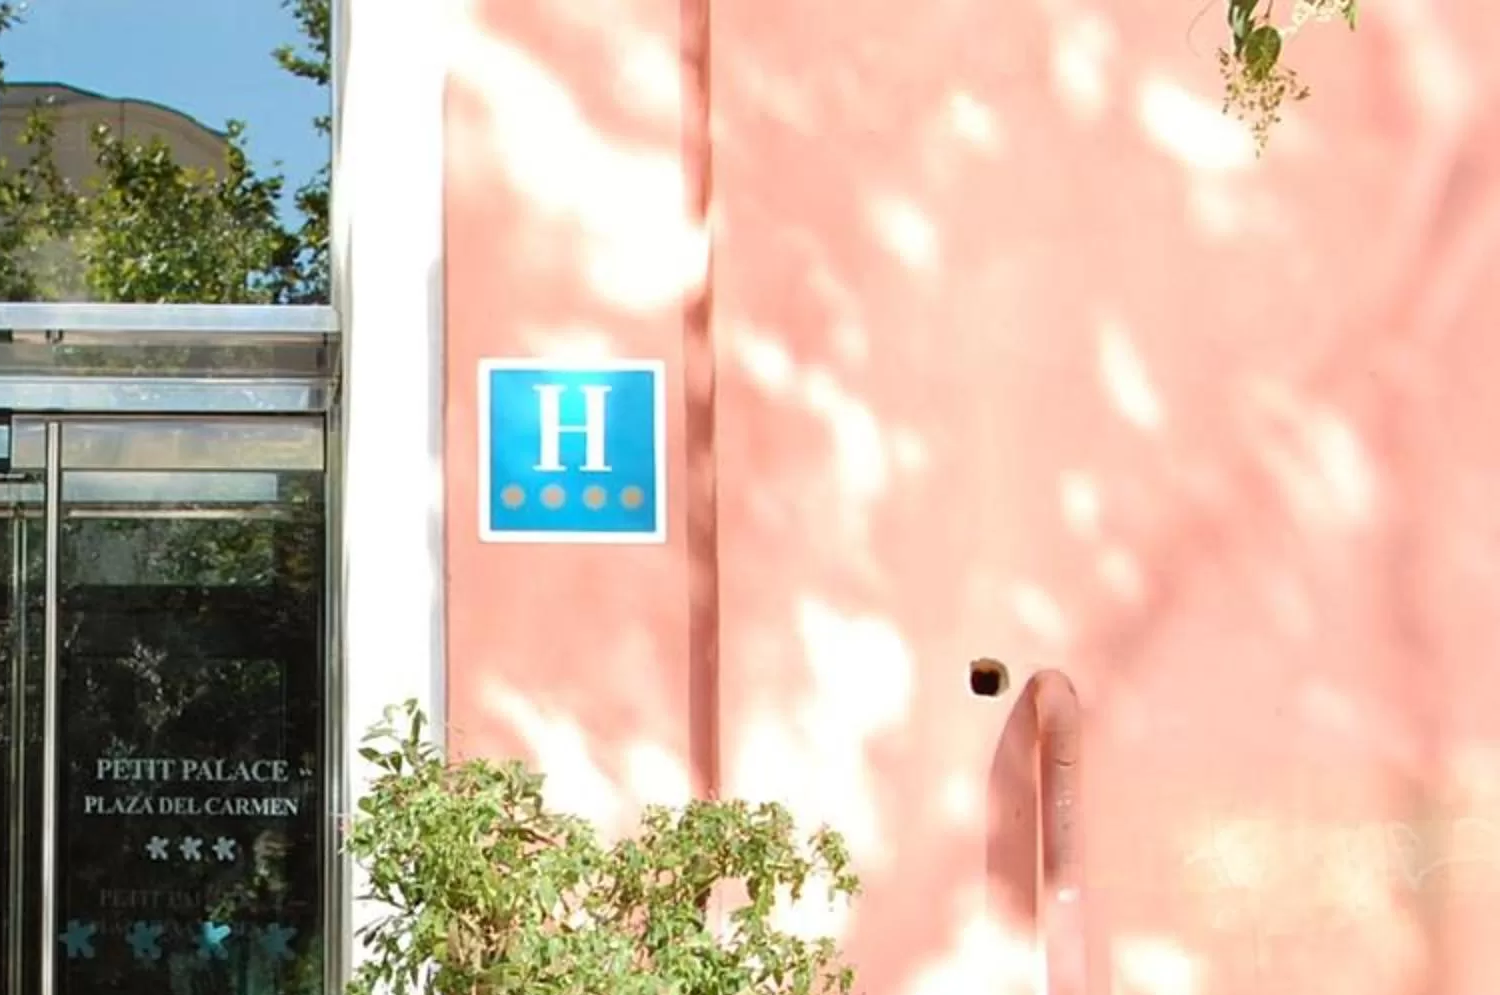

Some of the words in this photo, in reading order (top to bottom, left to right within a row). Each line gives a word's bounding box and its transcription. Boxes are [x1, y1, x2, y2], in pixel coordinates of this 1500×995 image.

[532, 384, 613, 473] H
[96, 758, 176, 782] PETIT
[181, 759, 289, 783] PALACE
[84, 795, 154, 815] PLAZA
[159, 796, 202, 816] DEL
[204, 797, 300, 817] CARMEN
